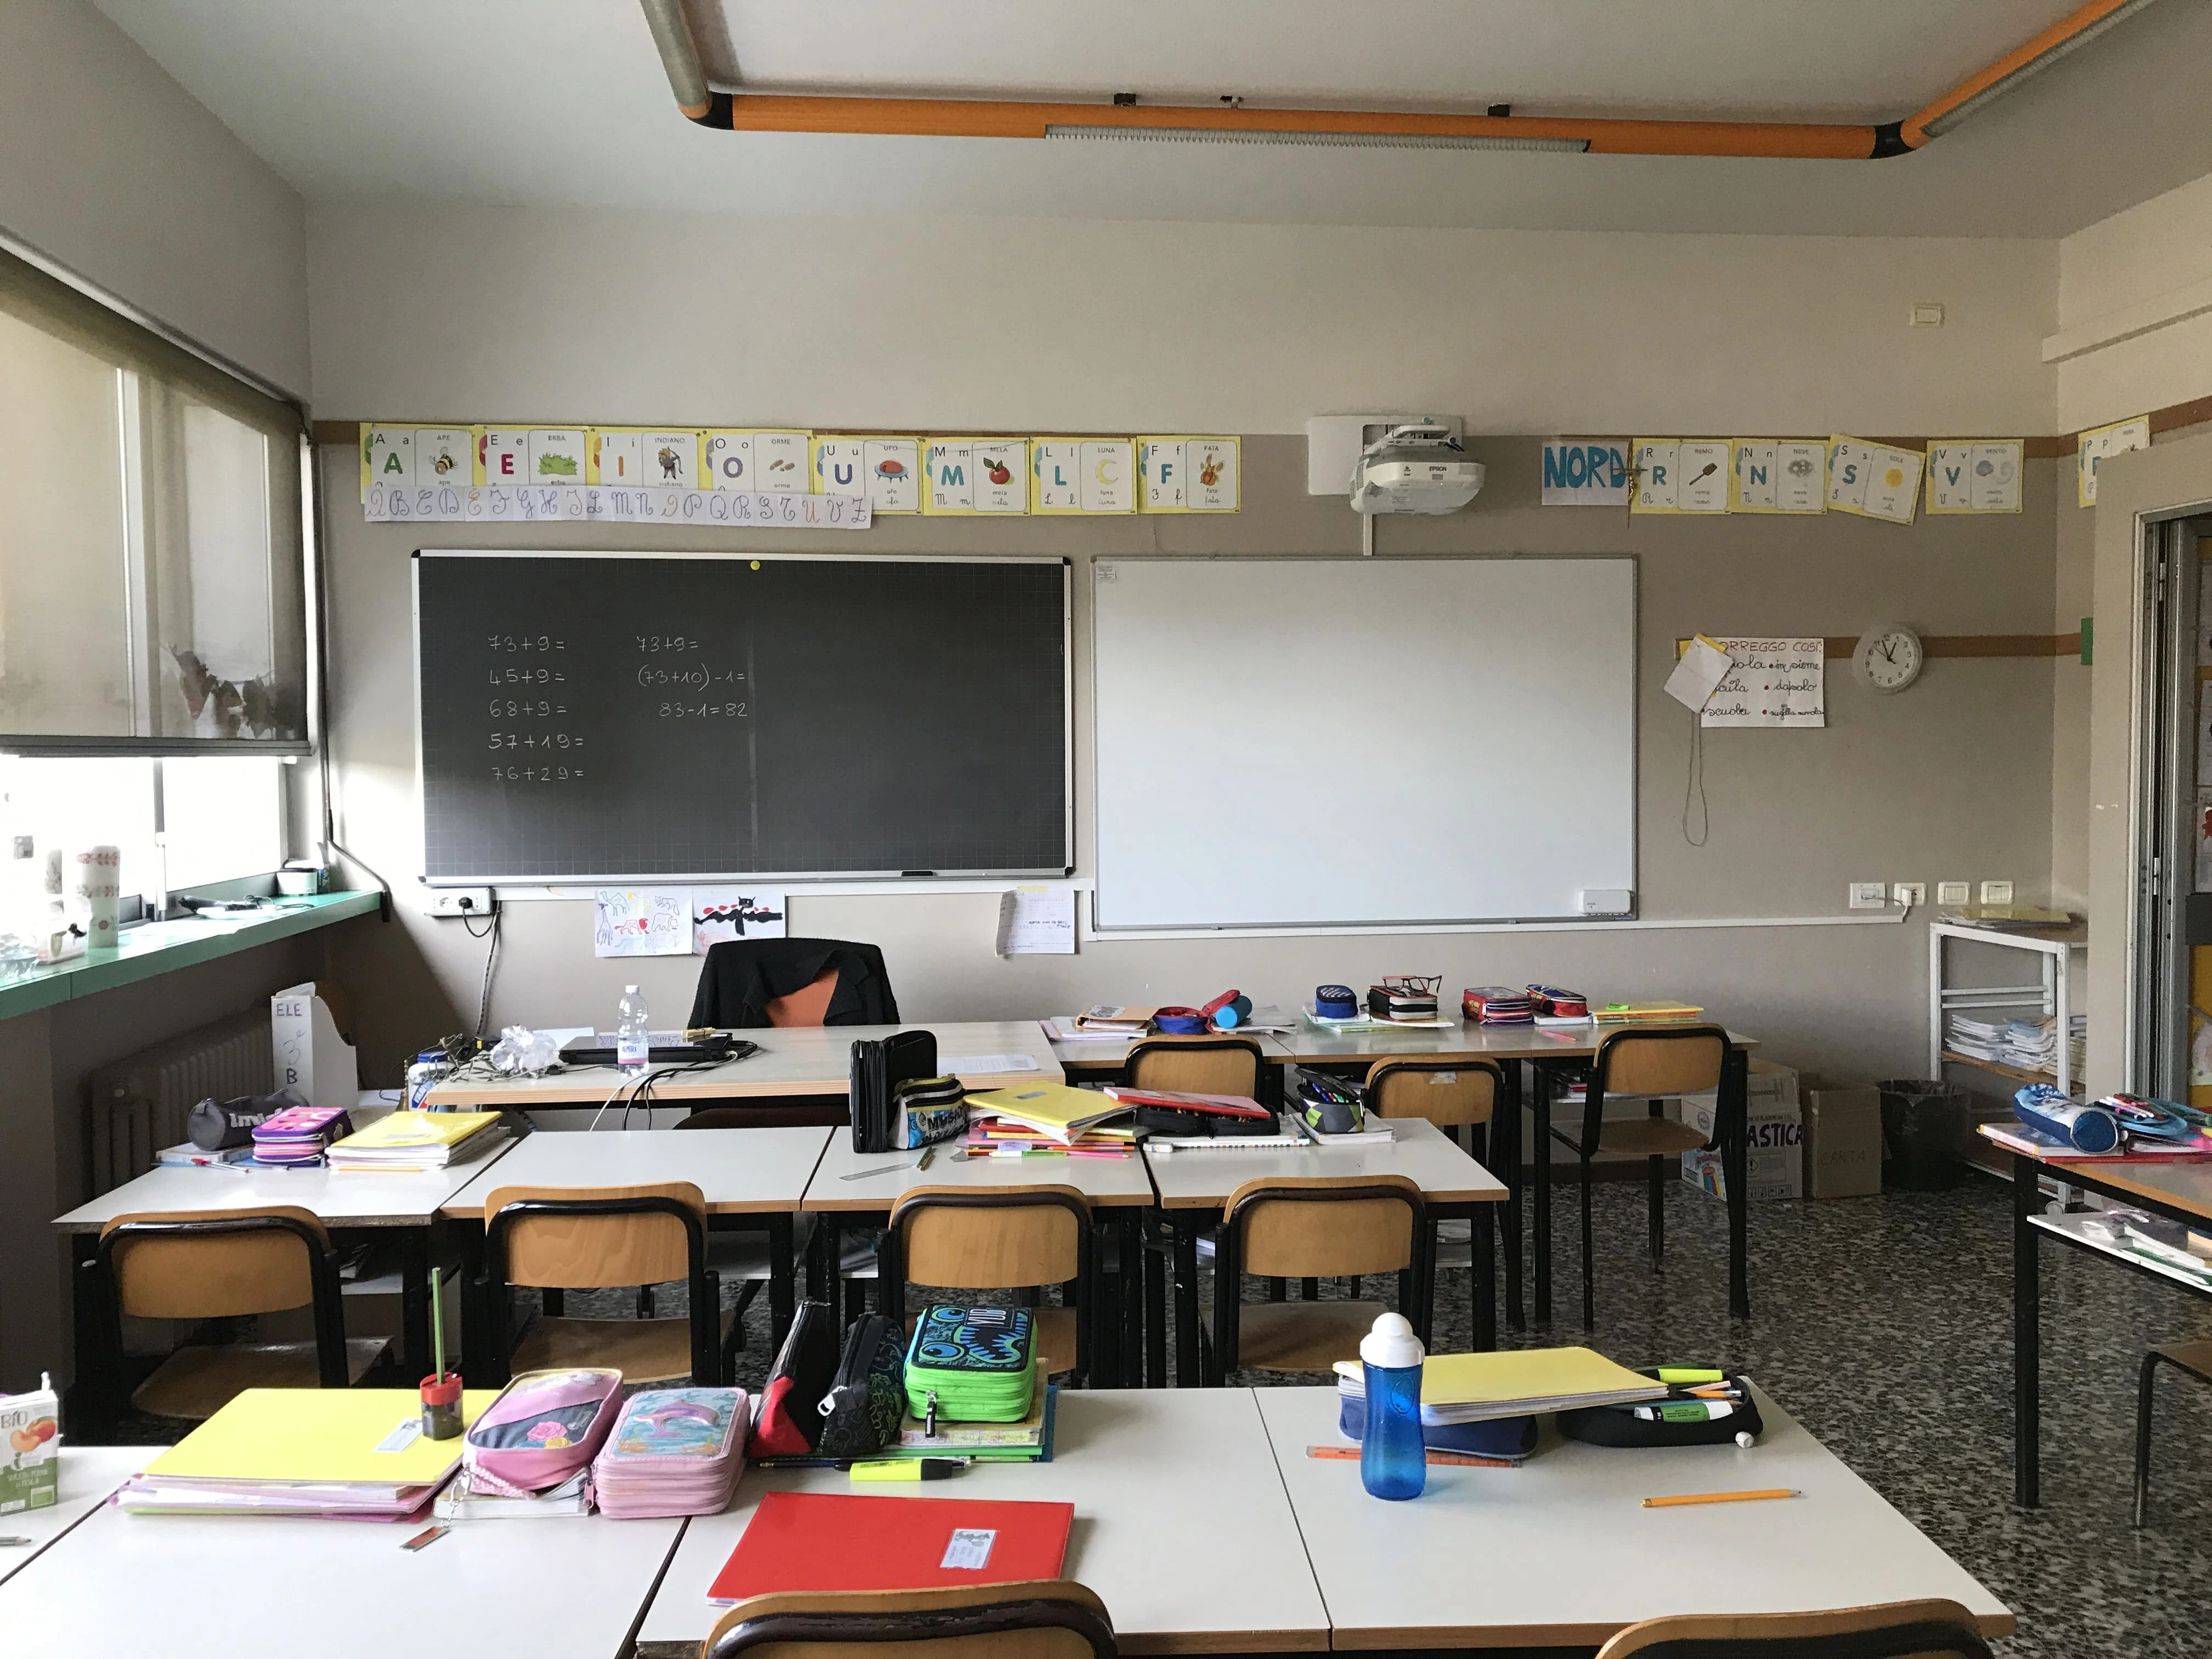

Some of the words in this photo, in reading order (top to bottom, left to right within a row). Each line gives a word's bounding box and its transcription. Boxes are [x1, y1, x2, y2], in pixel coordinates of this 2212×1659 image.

[375, 433, 385, 444] A
[490, 435, 498, 445] E
[607, 437, 610, 447] I
[715, 438, 726, 449] O
[827, 446, 835, 456] U
[935, 447, 945, 457] M
[1046, 447, 1052, 457] L
[1152, 445, 1159, 456] F
[1176, 445, 1181, 456] f
[1646, 448, 1653, 458] R
[1745, 447, 1753, 458] N
[1841, 445, 1848, 455] S
[1939, 449, 1946, 459] V
[384, 452, 403, 475] A
[501, 454, 514, 475] E
[618, 455, 624, 477] I
[1889, 455, 1904, 464] SOLE
[723, 457, 743, 478] O
[1544, 446, 1626, 488] NORD
[834, 464, 853, 485] U
[941, 465, 964, 486] M
[1055, 465, 1067, 486] L
[1161, 464, 1173, 484] F
[1652, 465, 1667, 486] R
[1750, 465, 1767, 485] N
[1842, 464, 1857, 484] S
[1945, 466, 1961, 487] V
[935, 493, 947, 505] M
[1045, 493, 1053, 505] L
[1642, 492, 1654, 504] R
[1742, 491, 1752, 503] N
[390, 489, 410, 516] B
[416, 489, 433, 515] C
[439, 488, 459, 515] D
[467, 488, 482, 516] E
[587, 490, 603, 514] L
[611, 491, 633, 515] M
[636, 493, 653, 516] N
[684, 494, 702, 518] P
[710, 495, 729, 520] Q
[733, 495, 751, 520] R
[759, 496, 772, 520] S
[802, 500, 820, 523] U
[851, 498, 867, 523] Z
[1718, 640, 1787, 652] ORREGGO
[276, 1003, 302, 1017] ELE
[286, 1068, 298, 1085] B
[1746, 1123, 1804, 1148] ASTICA
[1820, 1150, 1866, 1166] CARTA
